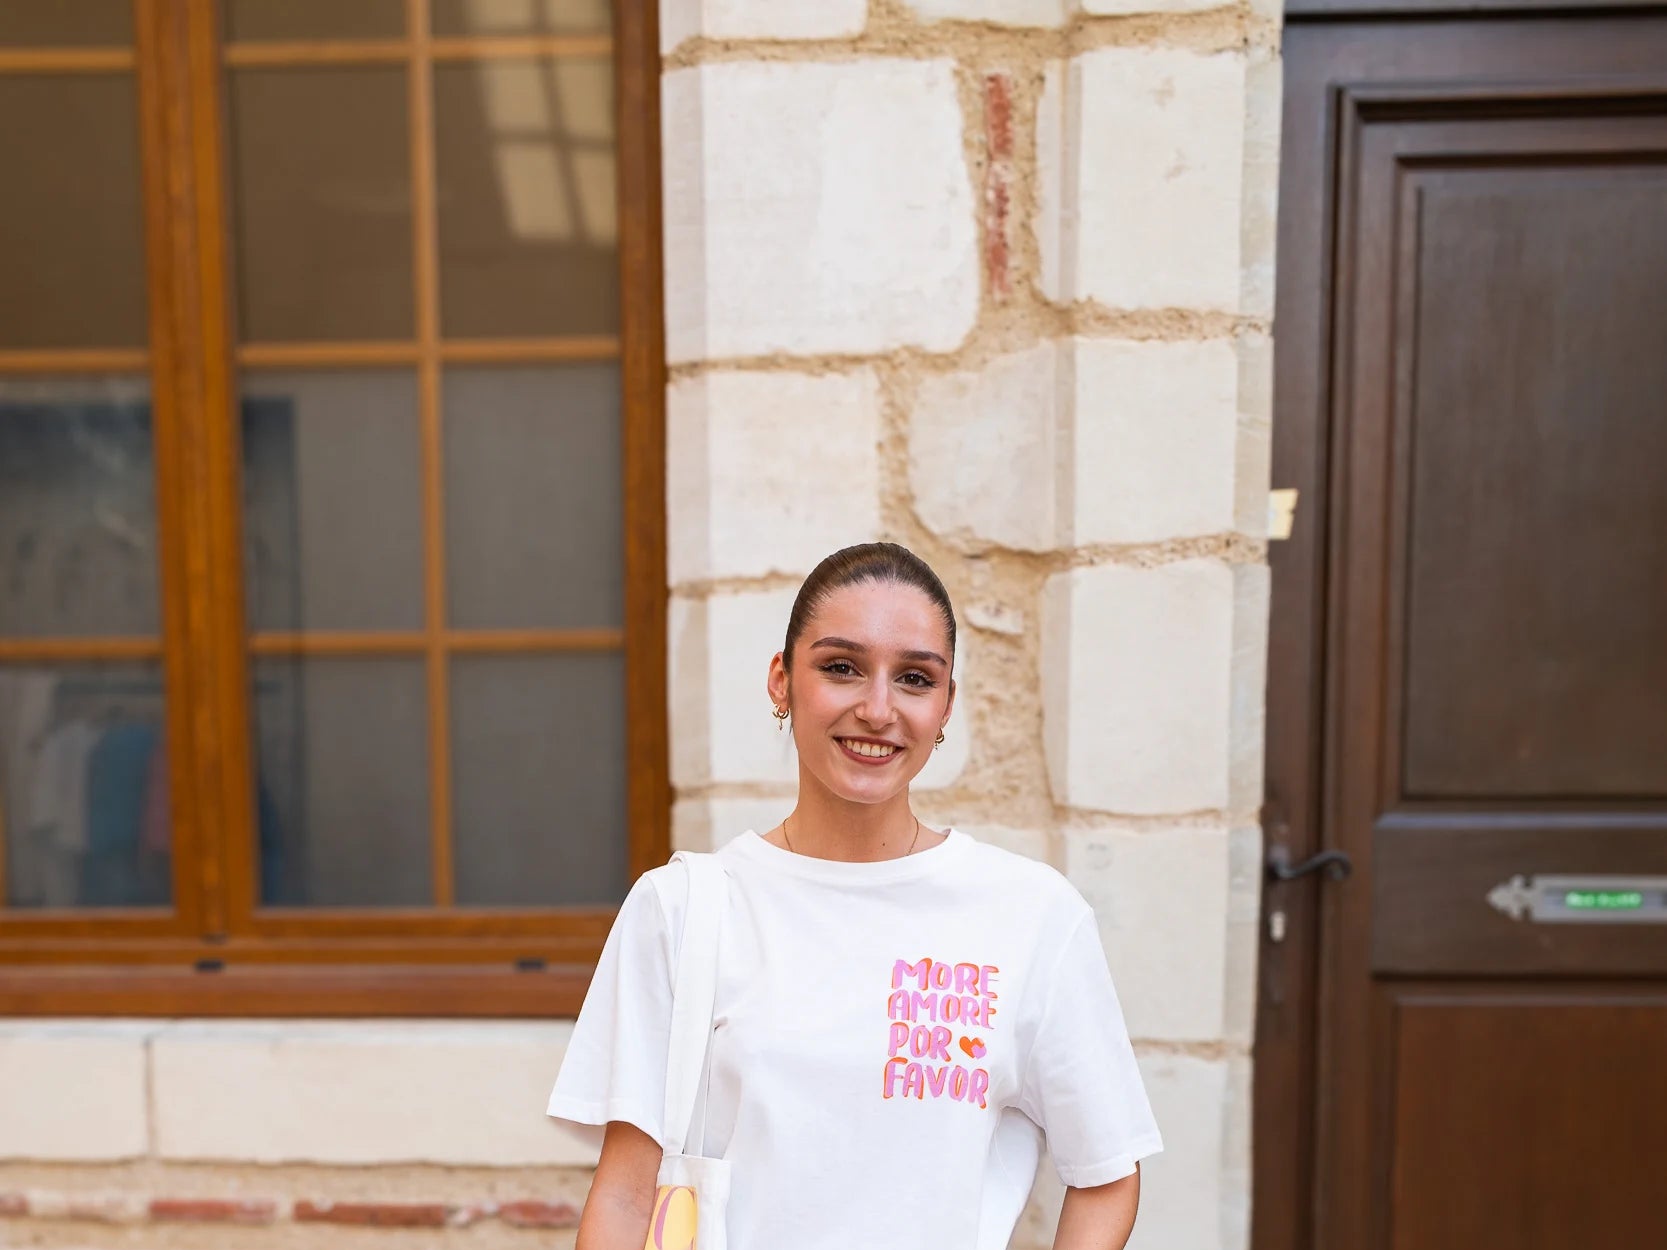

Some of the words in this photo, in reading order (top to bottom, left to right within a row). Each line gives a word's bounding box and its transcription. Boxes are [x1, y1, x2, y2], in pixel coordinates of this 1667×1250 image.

[892, 958, 999, 998] MORE
[888, 989, 997, 1029] AMORE
[888, 1022, 952, 1061] POR
[883, 1057, 989, 1109] FAVOR
